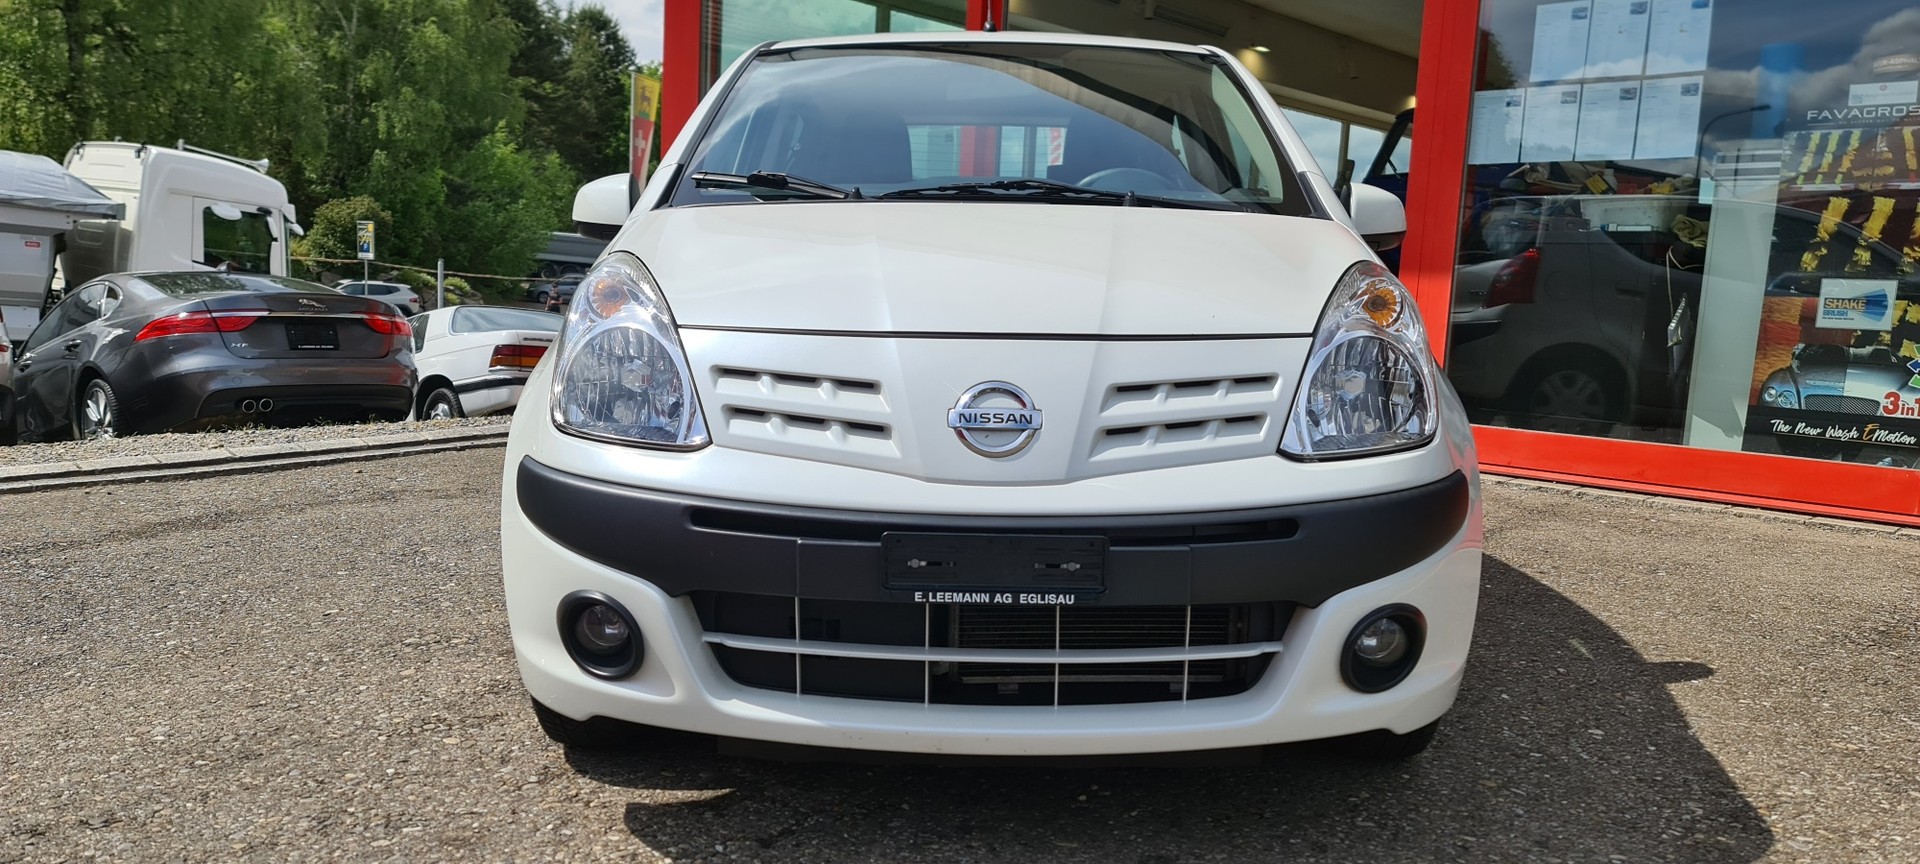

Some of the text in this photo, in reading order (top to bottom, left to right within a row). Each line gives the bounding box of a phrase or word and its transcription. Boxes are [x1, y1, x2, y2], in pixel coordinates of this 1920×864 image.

[1807, 105, 1920, 120] FAVAGROS
[1825, 298, 1866, 309] SHAKE
[1823, 309, 1849, 317] BRUSH
[958, 413, 1033, 424] NISSAN
[1770, 419, 1792, 433] The
[1794, 422, 1823, 436] New
[1825, 424, 1860, 441] Wash
[914, 592, 1075, 604] E. LEEMANN AG EGLISAU
